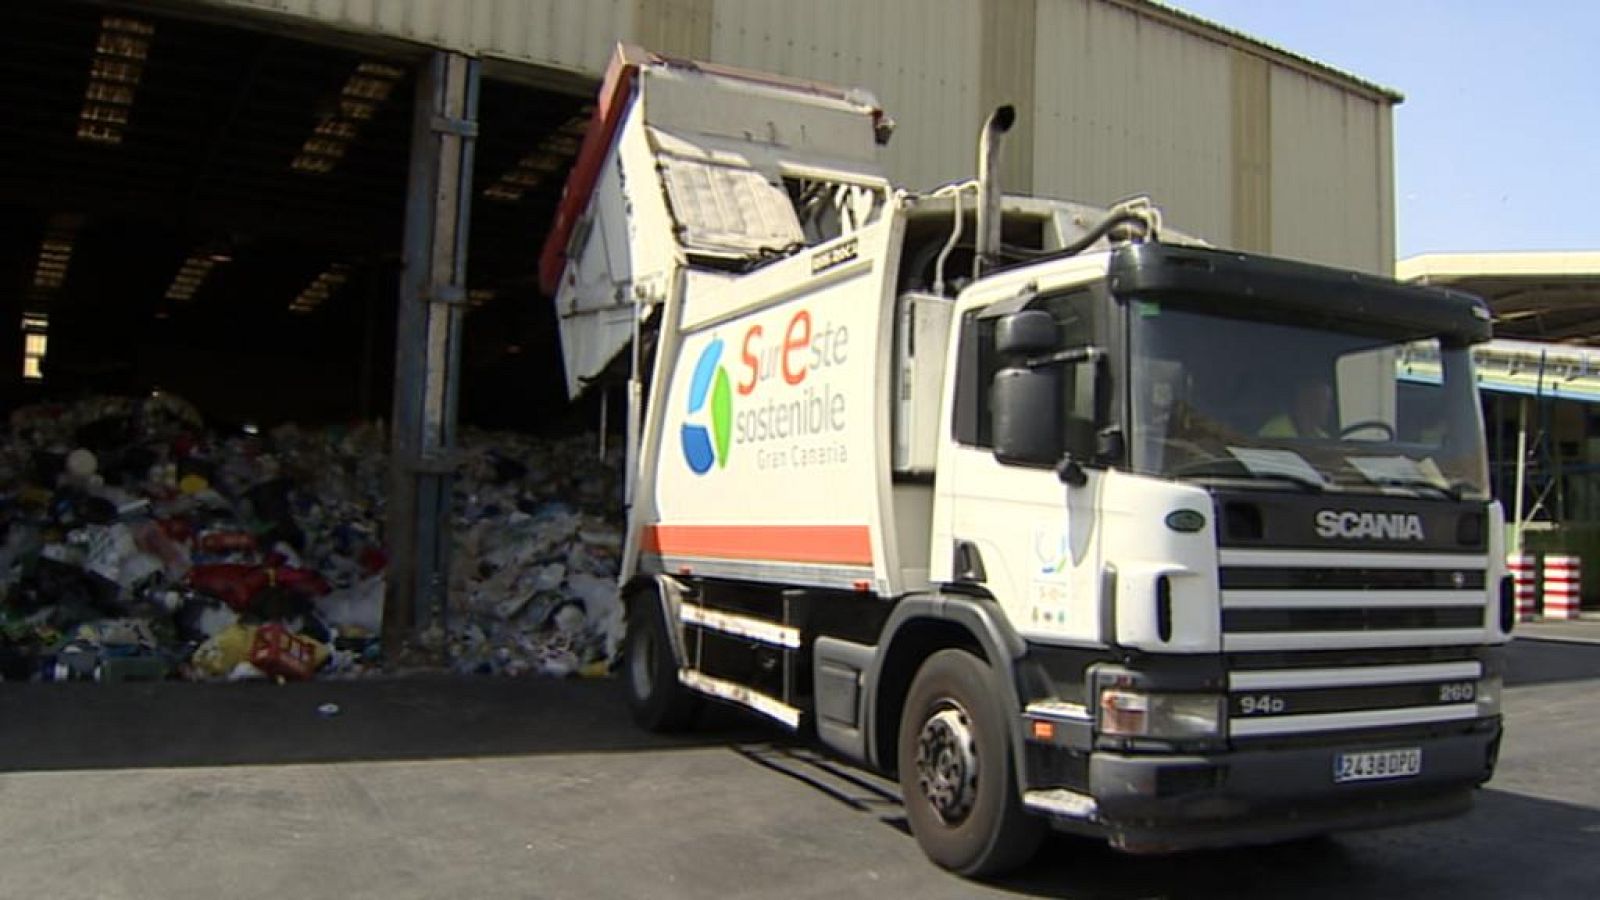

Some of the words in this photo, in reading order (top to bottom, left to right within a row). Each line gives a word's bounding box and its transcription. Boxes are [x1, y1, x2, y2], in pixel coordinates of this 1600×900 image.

[735, 383, 846, 445] sostenible
[1315, 510, 1424, 540] SCANIA
[1440, 683, 1473, 701] 260
